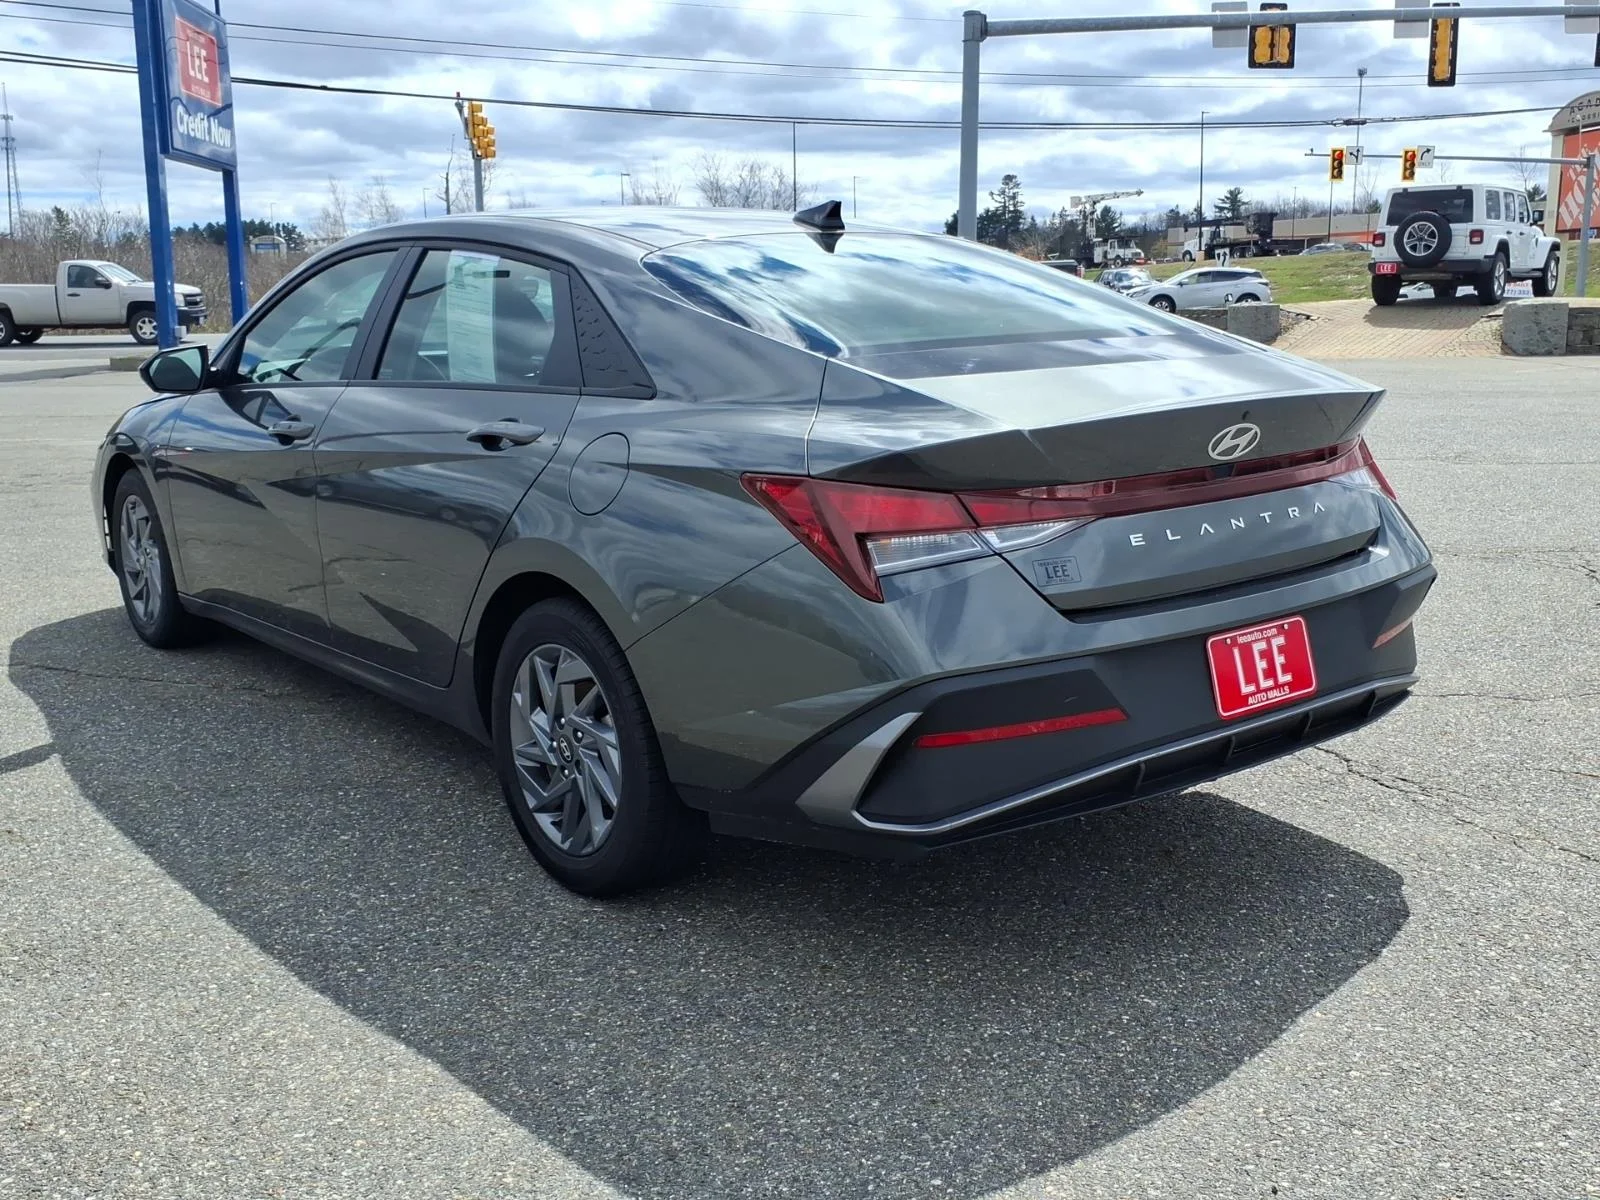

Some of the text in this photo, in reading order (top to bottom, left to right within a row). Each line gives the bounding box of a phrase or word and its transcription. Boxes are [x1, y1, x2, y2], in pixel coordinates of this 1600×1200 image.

[187, 41, 209, 83] LEE
[176, 105, 231, 148] Credit Now
[1380, 264, 1392, 272] LEE
[1129, 502, 1325, 546] ELANTRA
[1045, 564, 1070, 579] LEE
[1237, 628, 1278, 644] leeauto.com
[1232, 635, 1293, 695] LEE
[1248, 686, 1290, 706] AUTO MALLS
